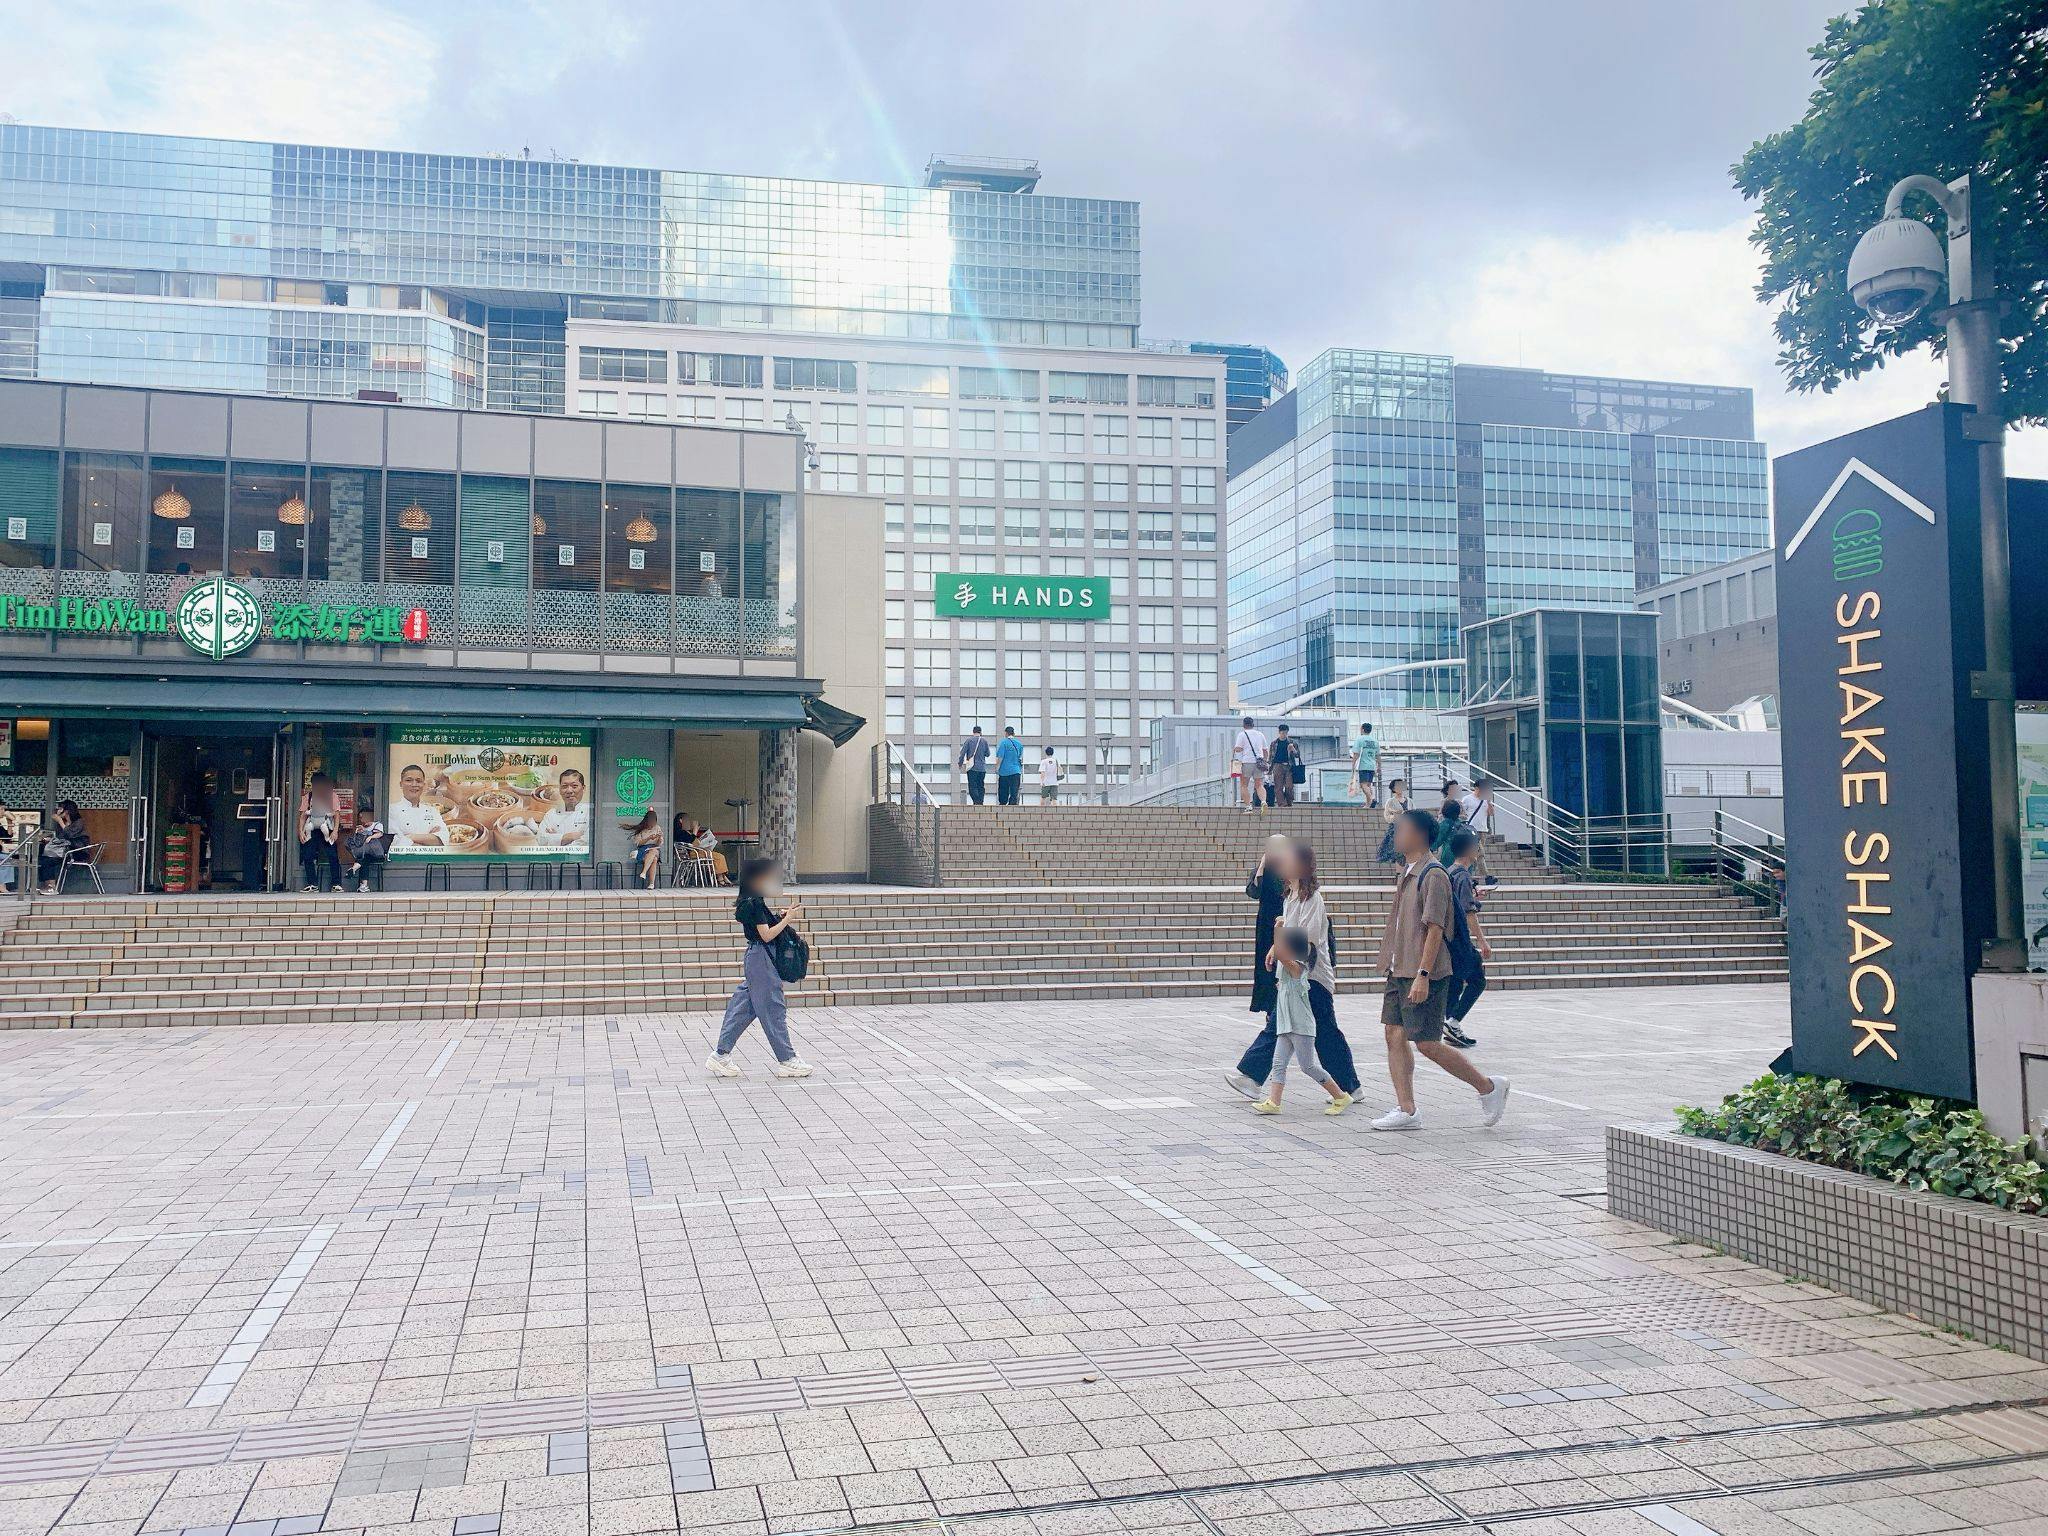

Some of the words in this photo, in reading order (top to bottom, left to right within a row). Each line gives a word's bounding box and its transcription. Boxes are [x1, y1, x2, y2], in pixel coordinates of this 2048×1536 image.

[0, 594, 168, 633] TimHoWan
[992, 586, 1093, 608] HANDS
[272, 602, 403, 643] 添好運
[1836, 591, 1888, 808] SHAKE
[424, 754, 476, 765] TimHoWan
[616, 758, 655, 767] TimHoWan
[1844, 830, 1898, 1061] SHACK
